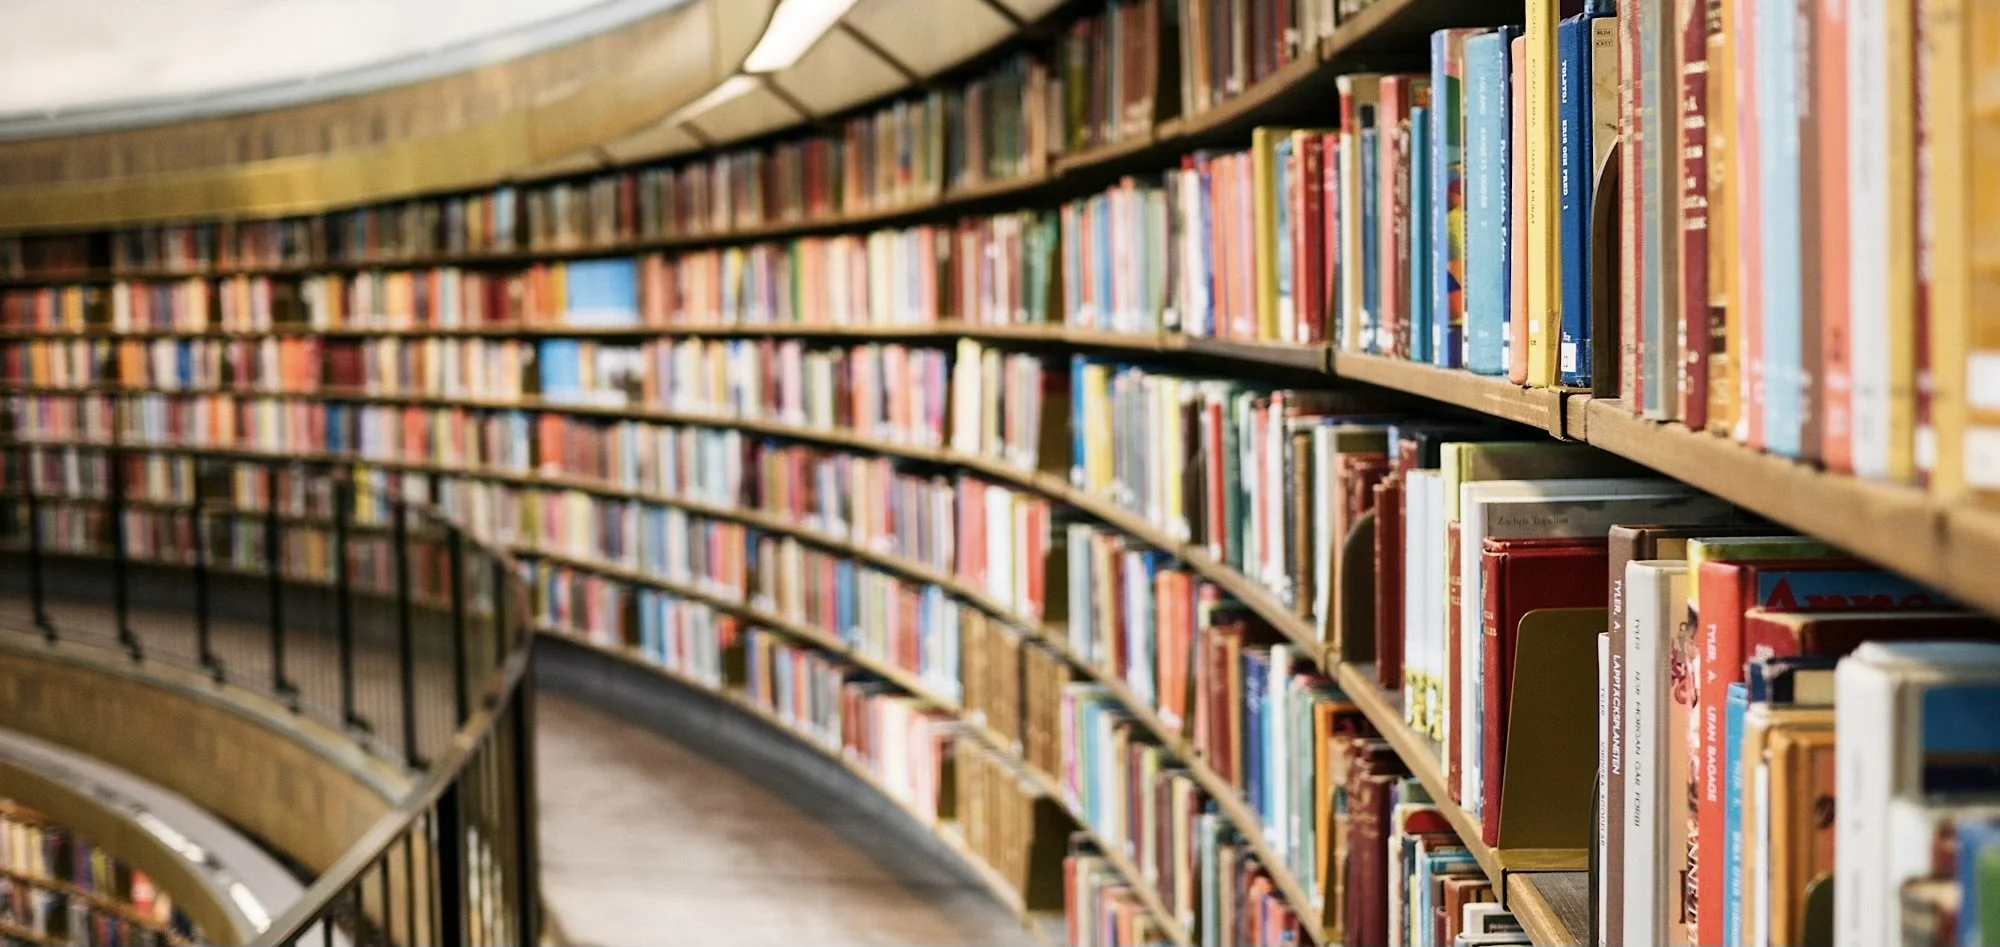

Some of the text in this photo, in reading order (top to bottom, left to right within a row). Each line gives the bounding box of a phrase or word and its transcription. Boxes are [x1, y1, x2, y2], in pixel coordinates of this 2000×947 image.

[1613, 579, 1622, 615] TYLER,
[1764, 578, 1933, 610] Anne
[1706, 623, 1717, 663] TYLER,
[1707, 706, 1717, 742] UTAN
[1707, 745, 1717, 802] BAGAGE
